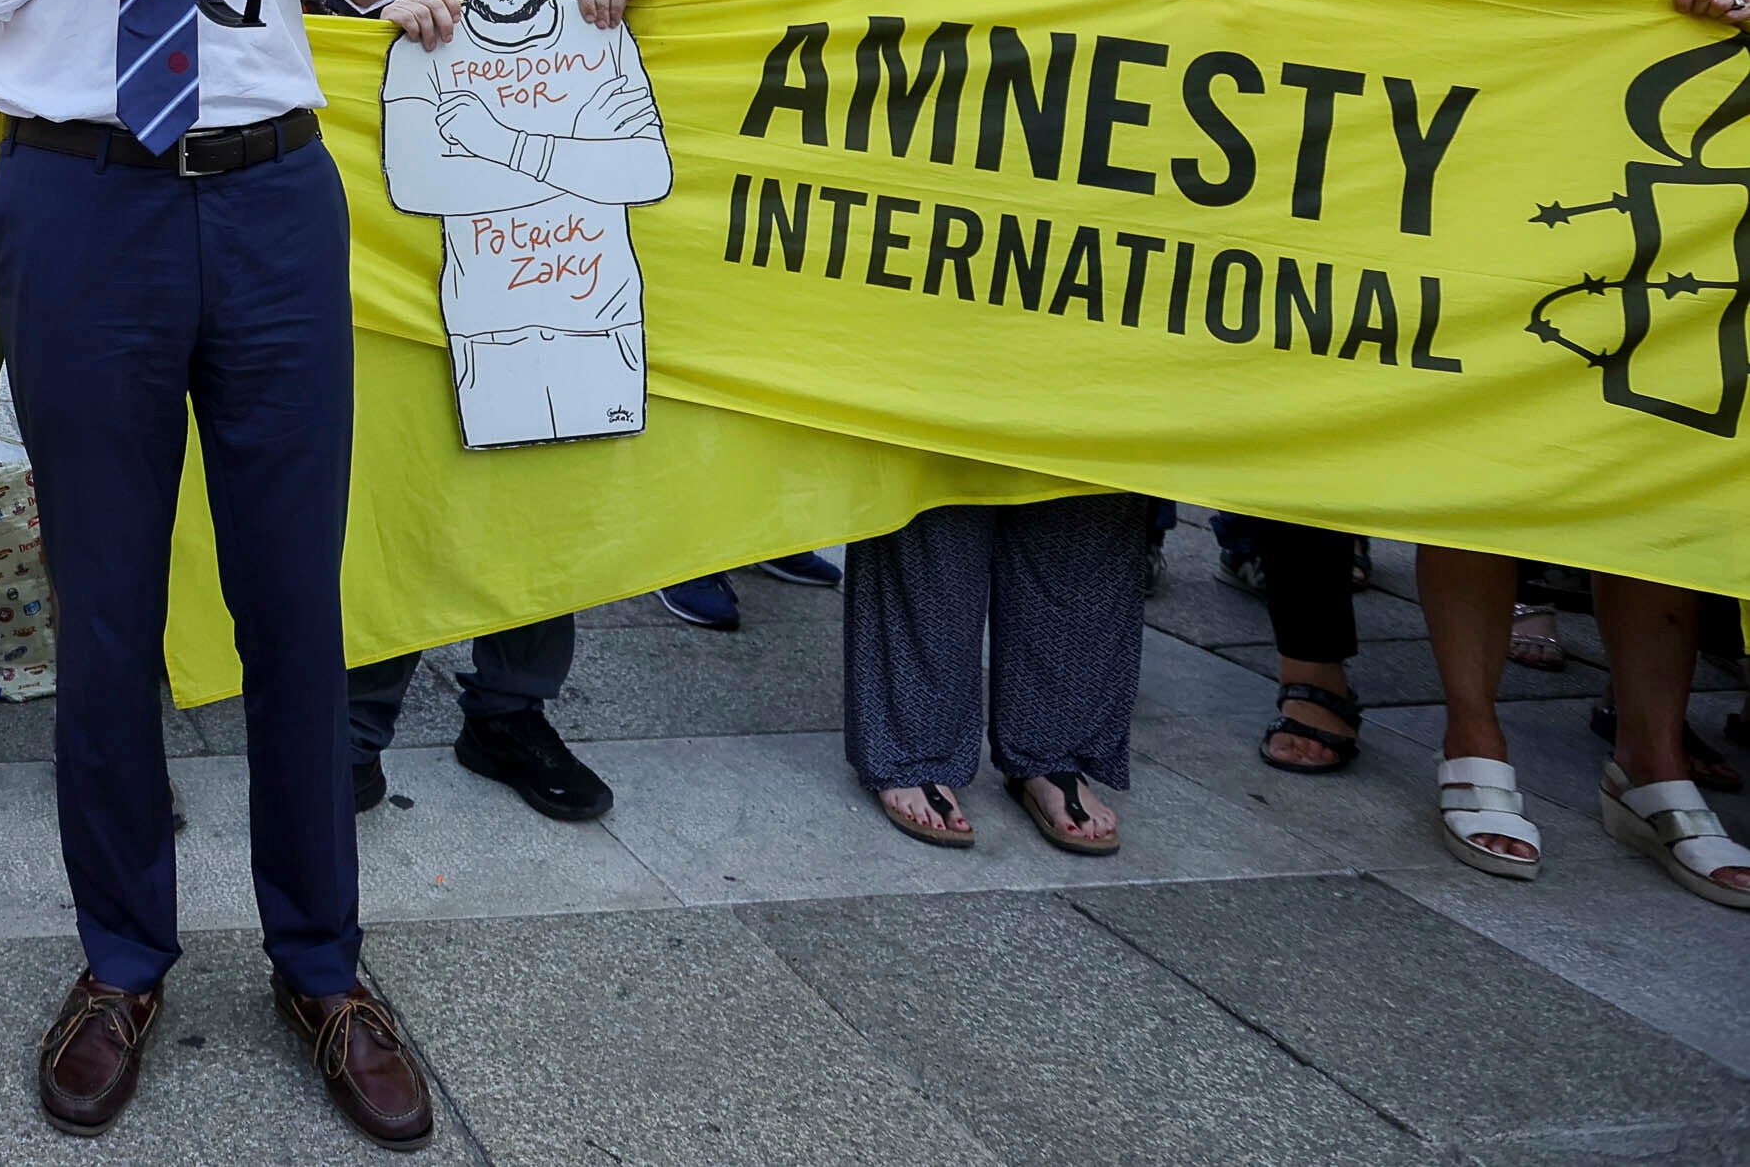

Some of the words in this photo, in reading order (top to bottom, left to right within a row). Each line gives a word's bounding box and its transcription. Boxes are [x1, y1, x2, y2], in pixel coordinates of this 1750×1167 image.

[497, 82, 568, 108] FOR
[740, 17, 1480, 236] AMNESTY
[724, 174, 1462, 373] INTERNATIONAL
